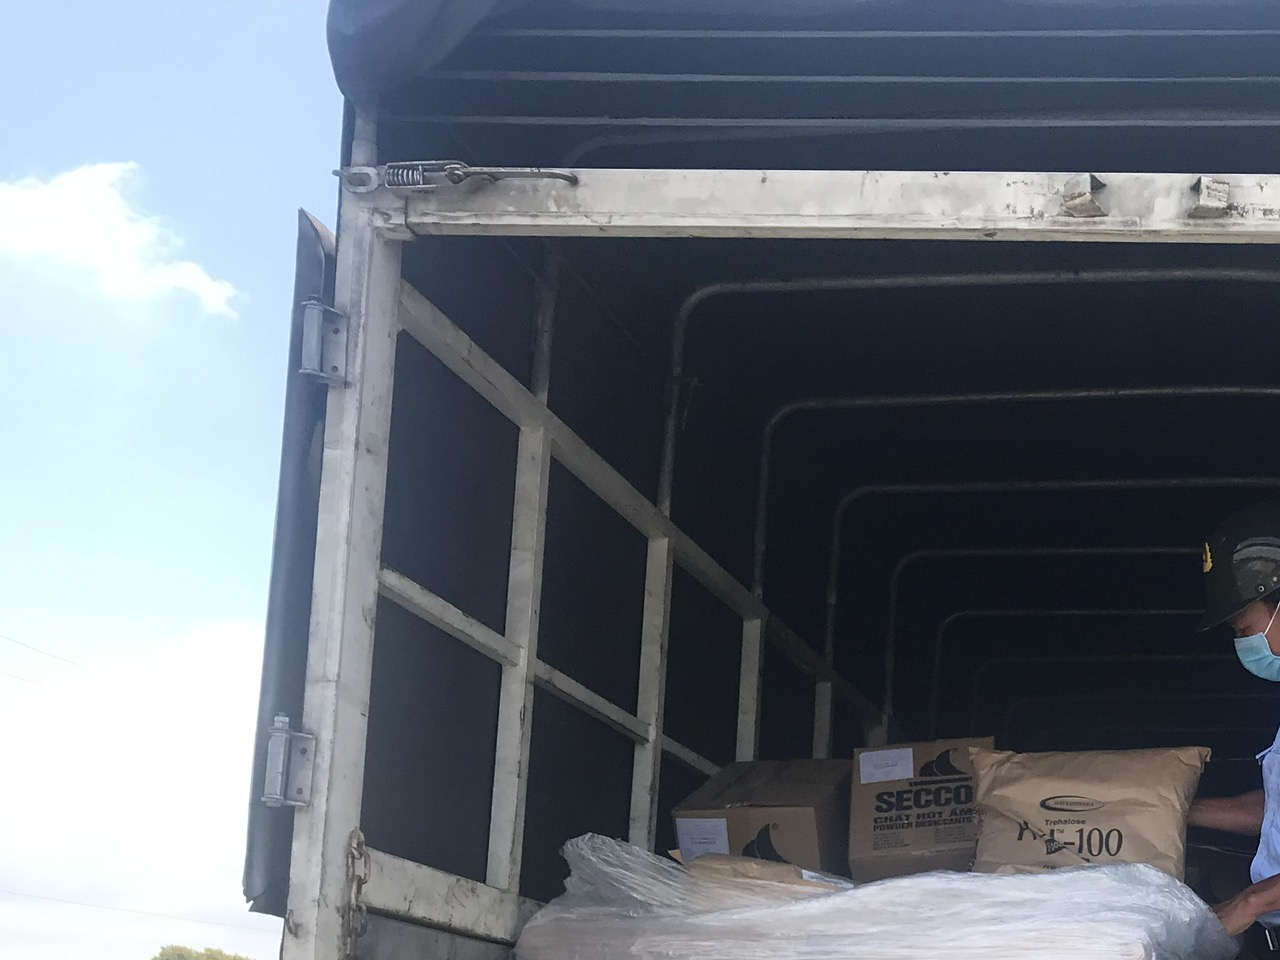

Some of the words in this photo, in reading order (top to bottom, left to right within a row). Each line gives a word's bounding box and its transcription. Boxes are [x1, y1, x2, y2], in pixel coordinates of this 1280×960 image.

[875, 784, 973, 813] SECCO
[873, 820, 913, 832] POWDER
[1044, 819, 1086, 827] Trehalose
